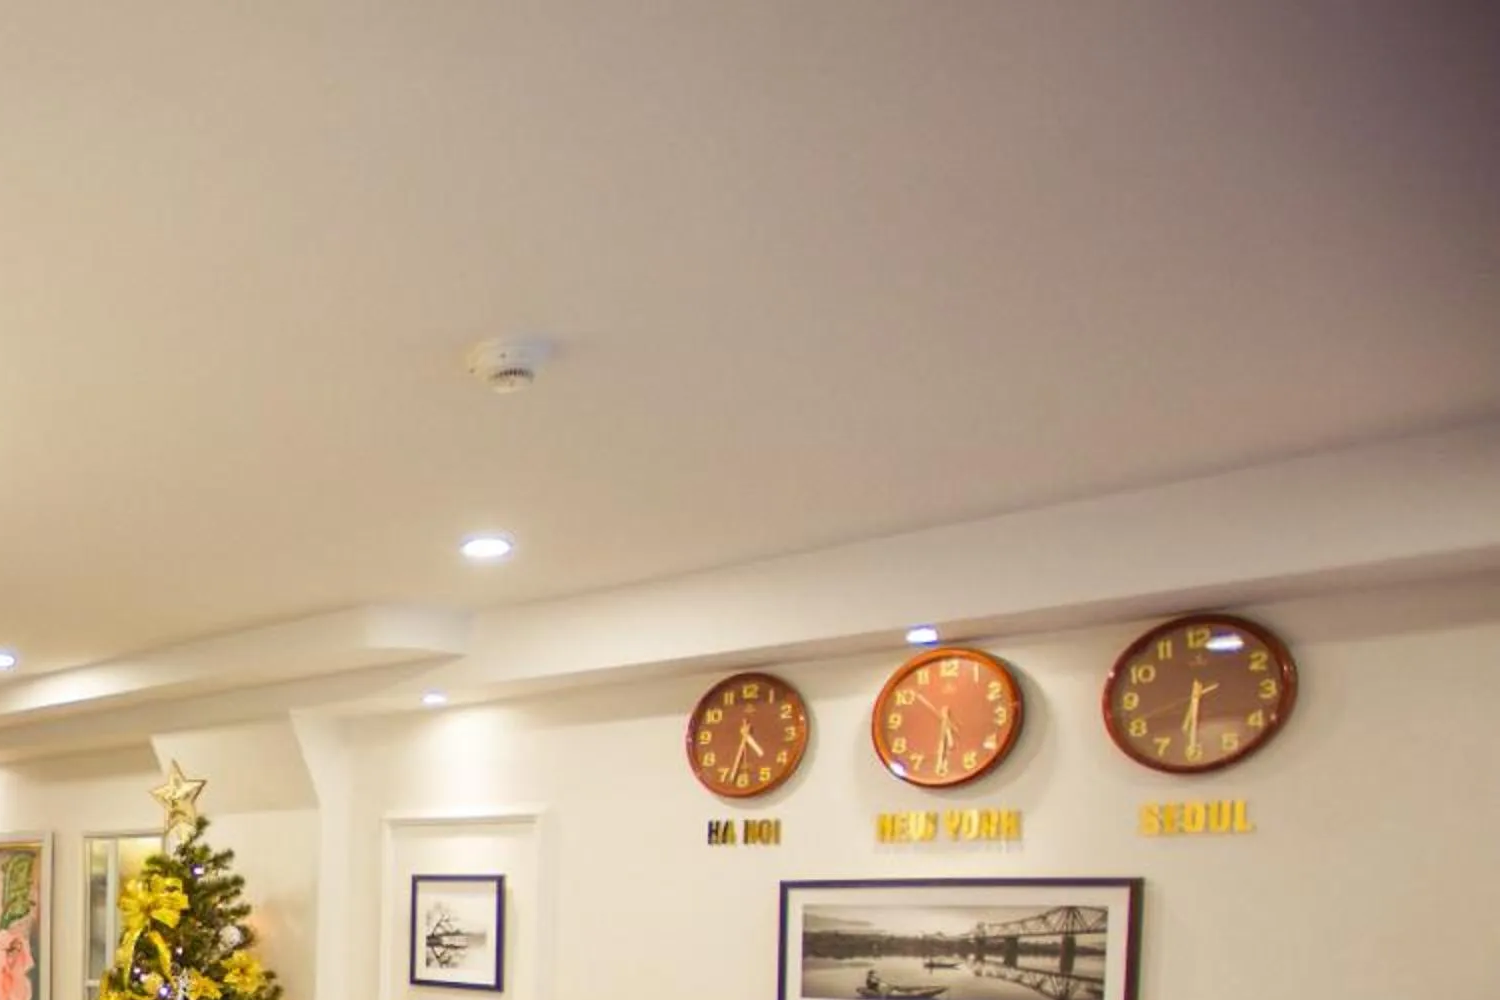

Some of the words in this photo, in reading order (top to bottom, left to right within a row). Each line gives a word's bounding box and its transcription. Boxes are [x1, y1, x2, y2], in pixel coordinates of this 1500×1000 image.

[1187, 627, 1211, 649] 12
[1157, 640, 1172, 660] 11
[940, 659, 959, 677] 12
[1249, 652, 1268, 671] 2
[916, 668, 930, 686] 11
[973, 661, 980, 682] 1
[1130, 664, 1156, 684] 10
[743, 683, 759, 699] 12
[895, 688, 915, 706] 10
[986, 681, 1002, 701] 2
[1259, 678, 1277, 699] 3
[723, 691, 735, 705] 11
[1122, 692, 1139, 711] 9
[706, 708, 723, 725] 10
[780, 703, 792, 719] 2
[994, 706, 1007, 726] 3
[1247, 709, 1264, 728] 4
[888, 712, 902, 730] 9
[1129, 718, 1148, 737] 8
[700, 730, 712, 745] 9
[784, 726, 796, 742] 3
[982, 733, 997, 750] 4
[1222, 732, 1239, 750] 5
[891, 736, 907, 755] 8
[1153, 737, 1171, 756] 7
[703, 751, 716, 767] 8
[776, 750, 788, 766] 4
[909, 753, 924, 771] 7
[963, 751, 977, 769] 5
[717, 767, 730, 782] 7
[736, 771, 749, 788] 6
[759, 766, 771, 781] 5
[877, 811, 937, 842] NEW
[944, 809, 1021, 841] YORK
[1139, 800, 1250, 837] SEOUL
[707, 819, 736, 845] HA
[743, 818, 781, 845] NOI
